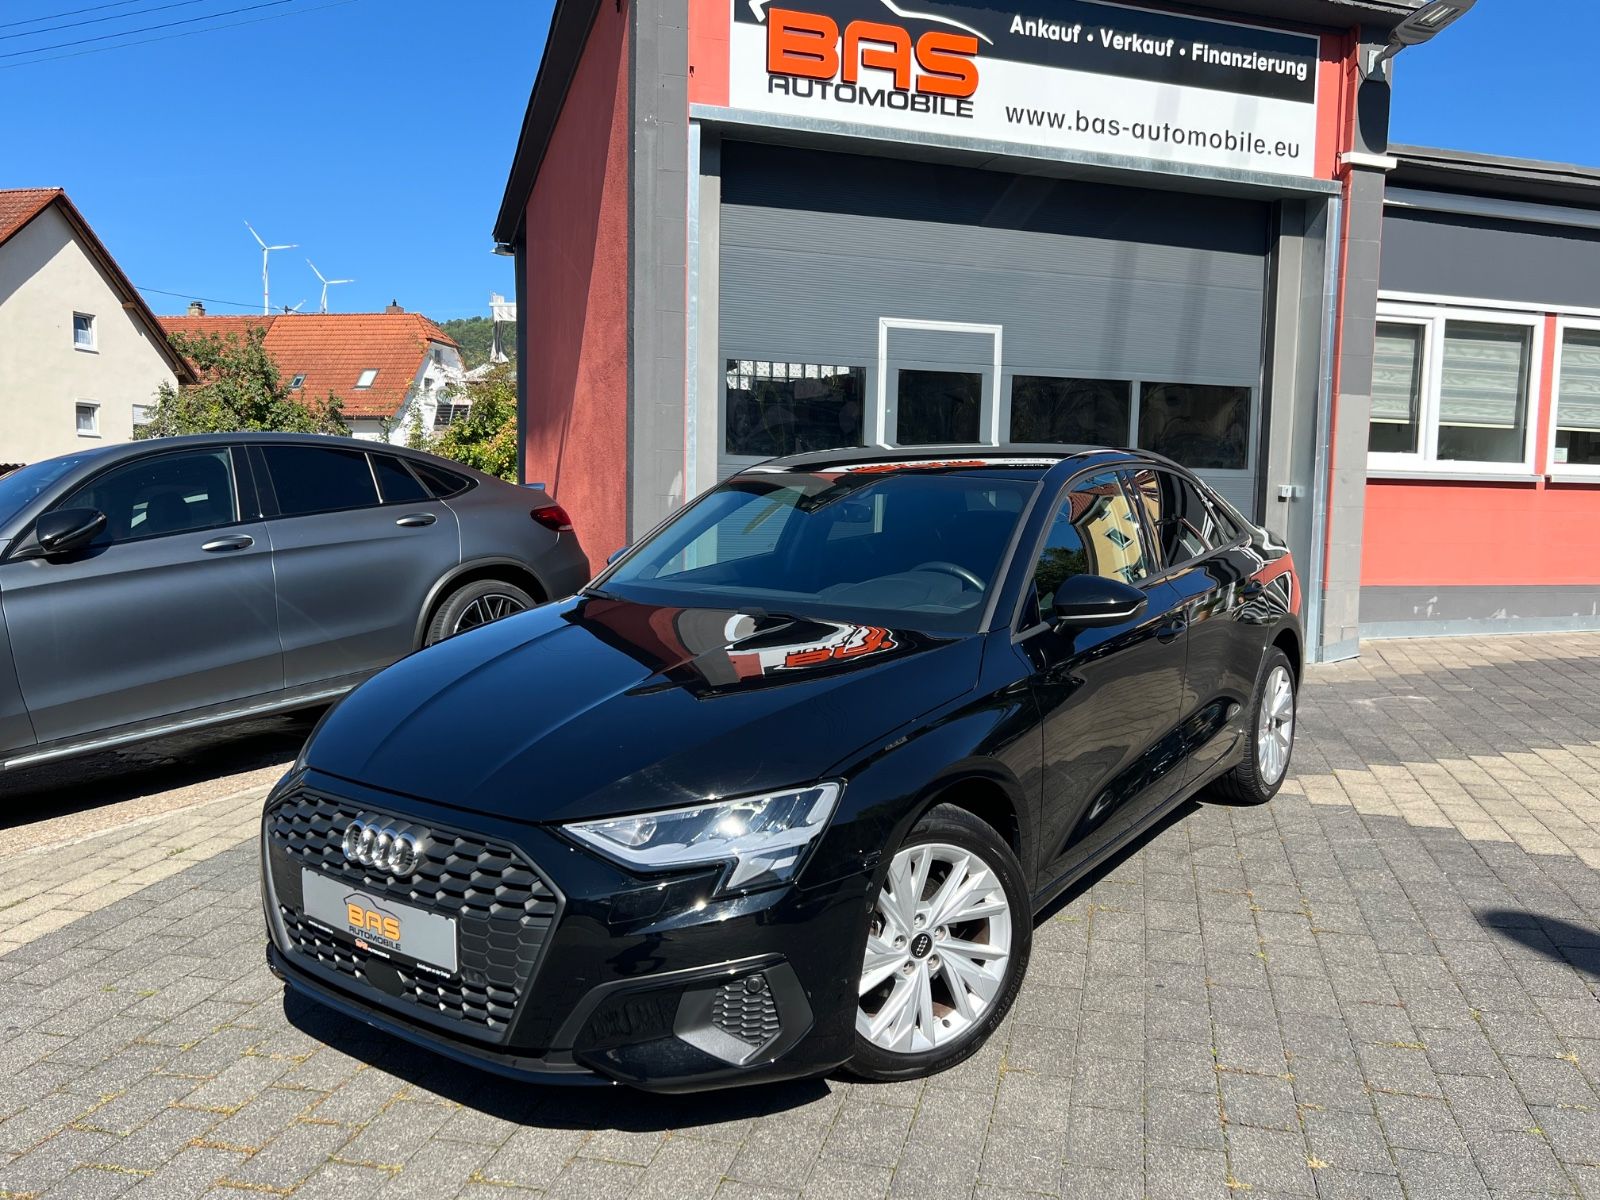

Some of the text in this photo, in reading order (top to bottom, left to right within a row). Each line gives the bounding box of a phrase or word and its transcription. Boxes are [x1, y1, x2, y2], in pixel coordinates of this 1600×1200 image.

[767, 8, 979, 98] BAS
[1009, 15, 1308, 81] Ankauf Verkauf Finanzierung
[768, 74, 974, 118] AUTOMOBILE
[1005, 105, 1301, 159] www.bas-automobile.eu
[348, 903, 401, 941] BAS
[349, 925, 402, 951] AUTOMOBILE
